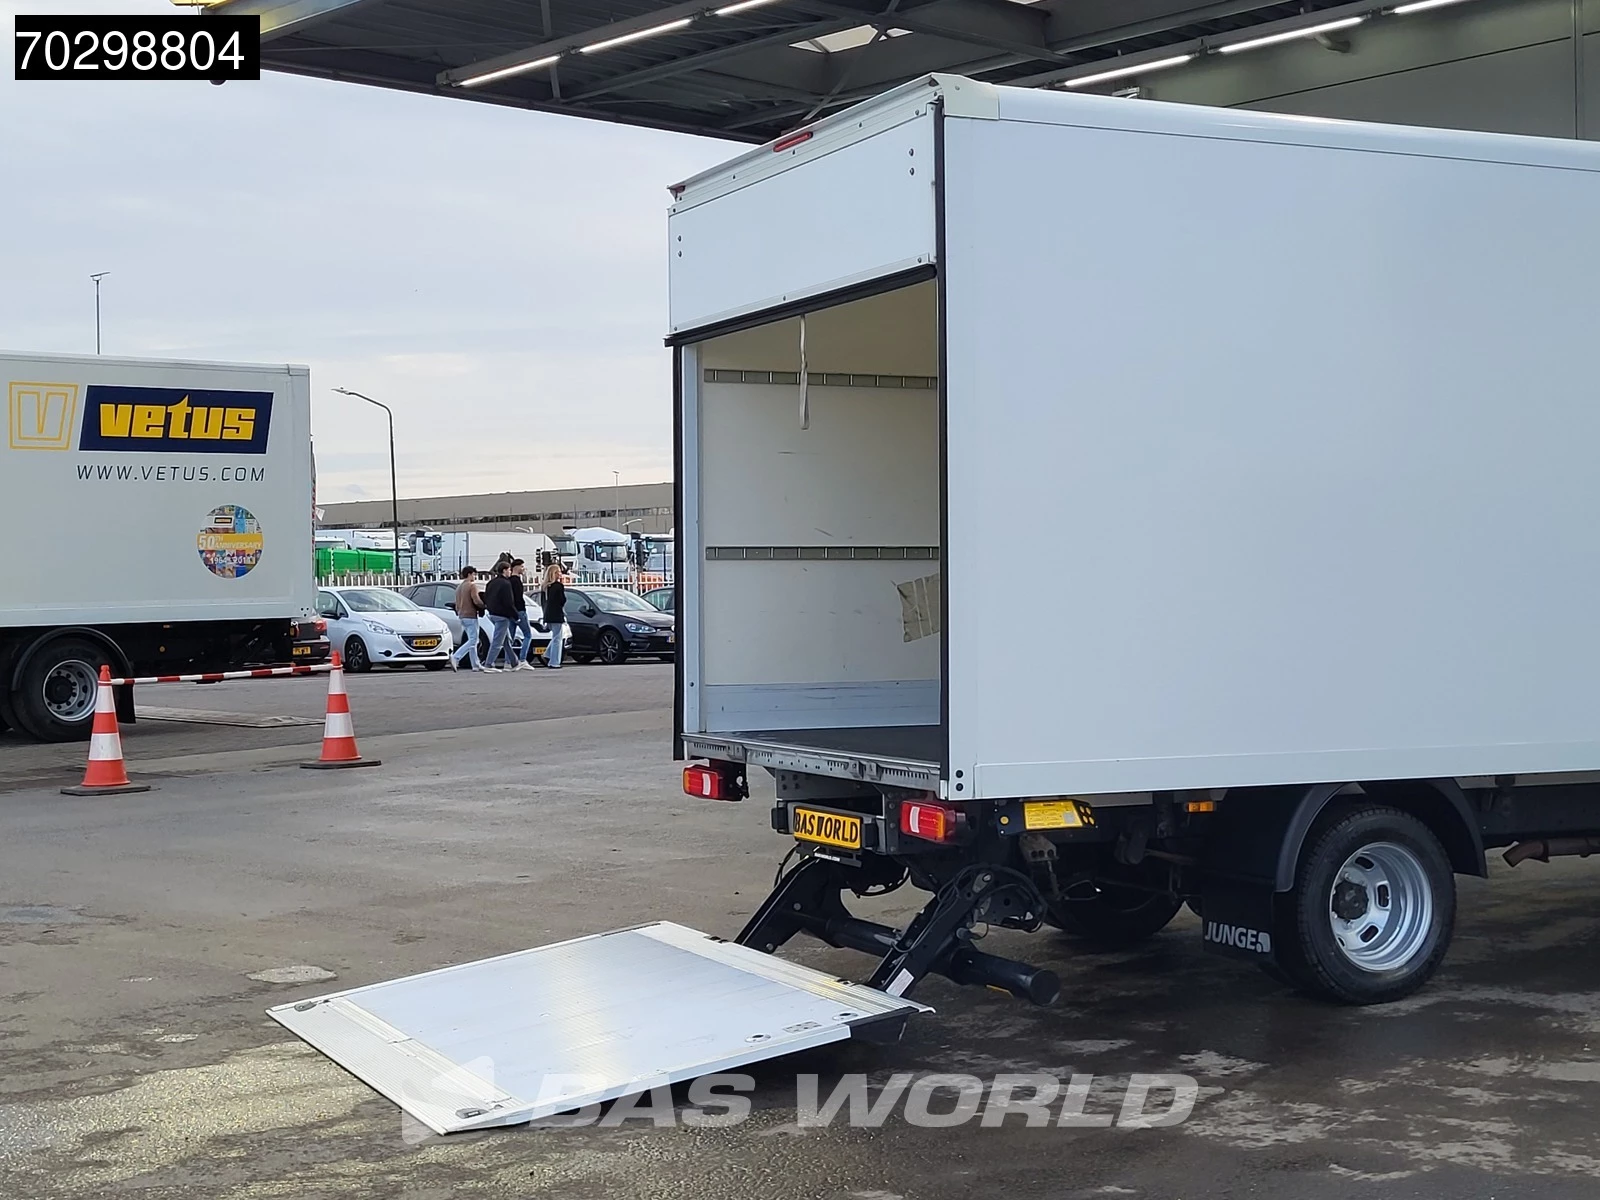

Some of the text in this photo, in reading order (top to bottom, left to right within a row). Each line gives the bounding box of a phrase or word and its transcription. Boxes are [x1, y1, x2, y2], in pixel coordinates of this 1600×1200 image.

[100, 395, 256, 440] vetus
[77, 465, 265, 482] WWW.VETUS.COM
[794, 812, 815, 836] BAS
[1204, 921, 1258, 950] JUNGE
